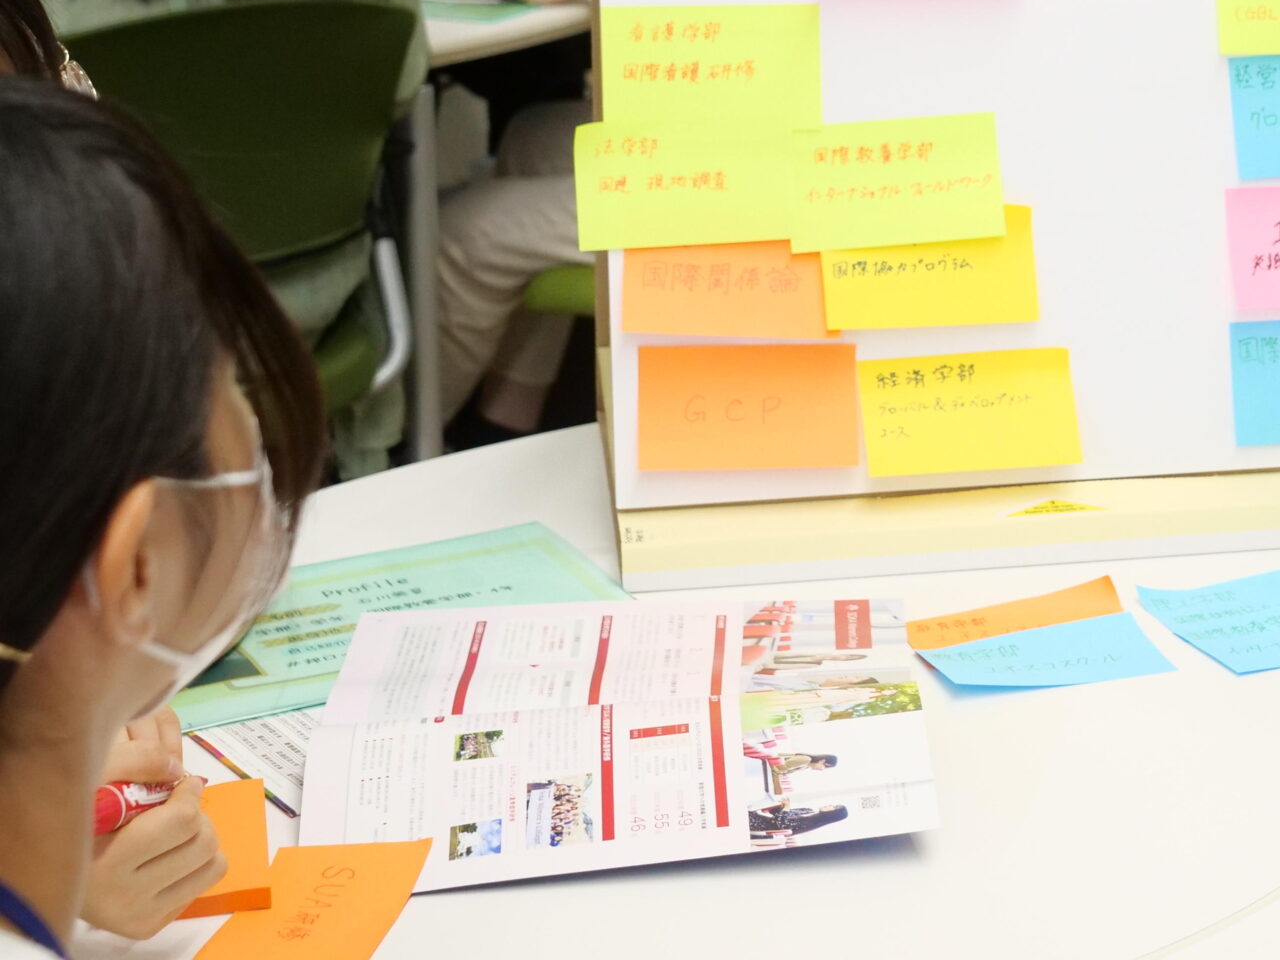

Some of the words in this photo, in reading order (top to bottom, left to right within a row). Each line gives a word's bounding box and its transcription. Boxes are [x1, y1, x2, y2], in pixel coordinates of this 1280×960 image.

[593, 136, 658, 160] 法学部
[812, 140, 935, 165] 国際教養学部
[640, 259, 803, 295] 国際関係論
[875, 362, 976, 390] 経済学部
[878, 426, 911, 439] コース
[320, 577, 410, 599] Profile
